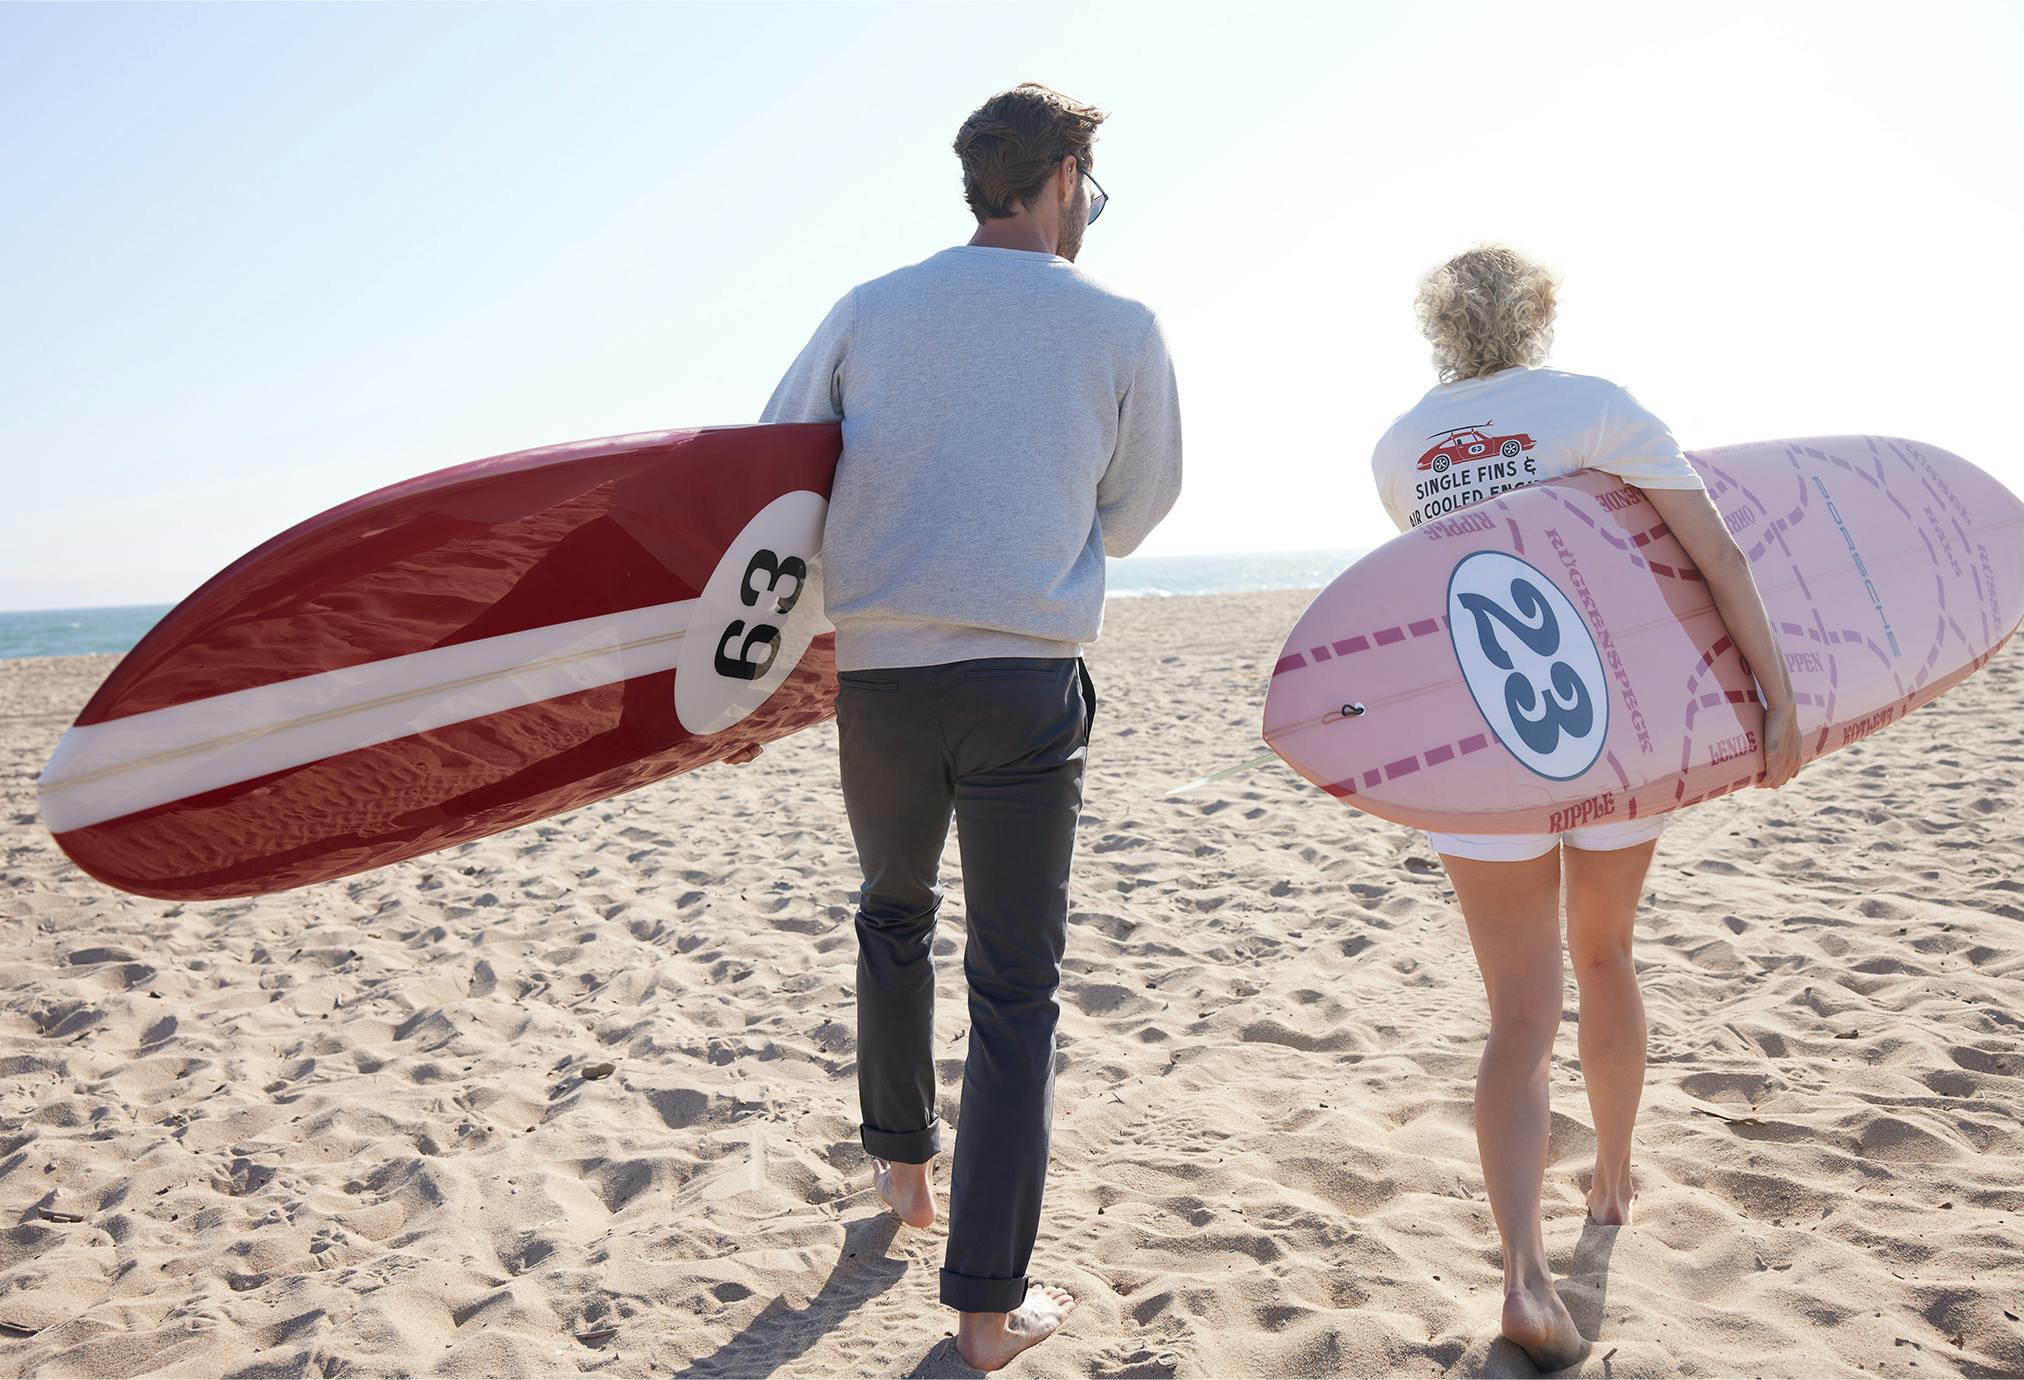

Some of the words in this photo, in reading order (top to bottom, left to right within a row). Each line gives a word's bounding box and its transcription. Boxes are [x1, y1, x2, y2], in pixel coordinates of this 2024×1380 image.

[1471, 445, 1482, 453] 63
[1416, 469, 1471, 500] SINGLE
[1478, 461, 1517, 482] FINS
[1523, 456, 1536, 475] &
[1595, 486, 1642, 512] ENDE
[1424, 489, 1484, 519] COOLED
[1812, 476, 1901, 658] PORSCHE
[714, 549, 807, 681] 63
[1457, 578, 1593, 755] 23
[1708, 731, 1757, 766] LENDE
[1549, 791, 1616, 834] RIPPLE
